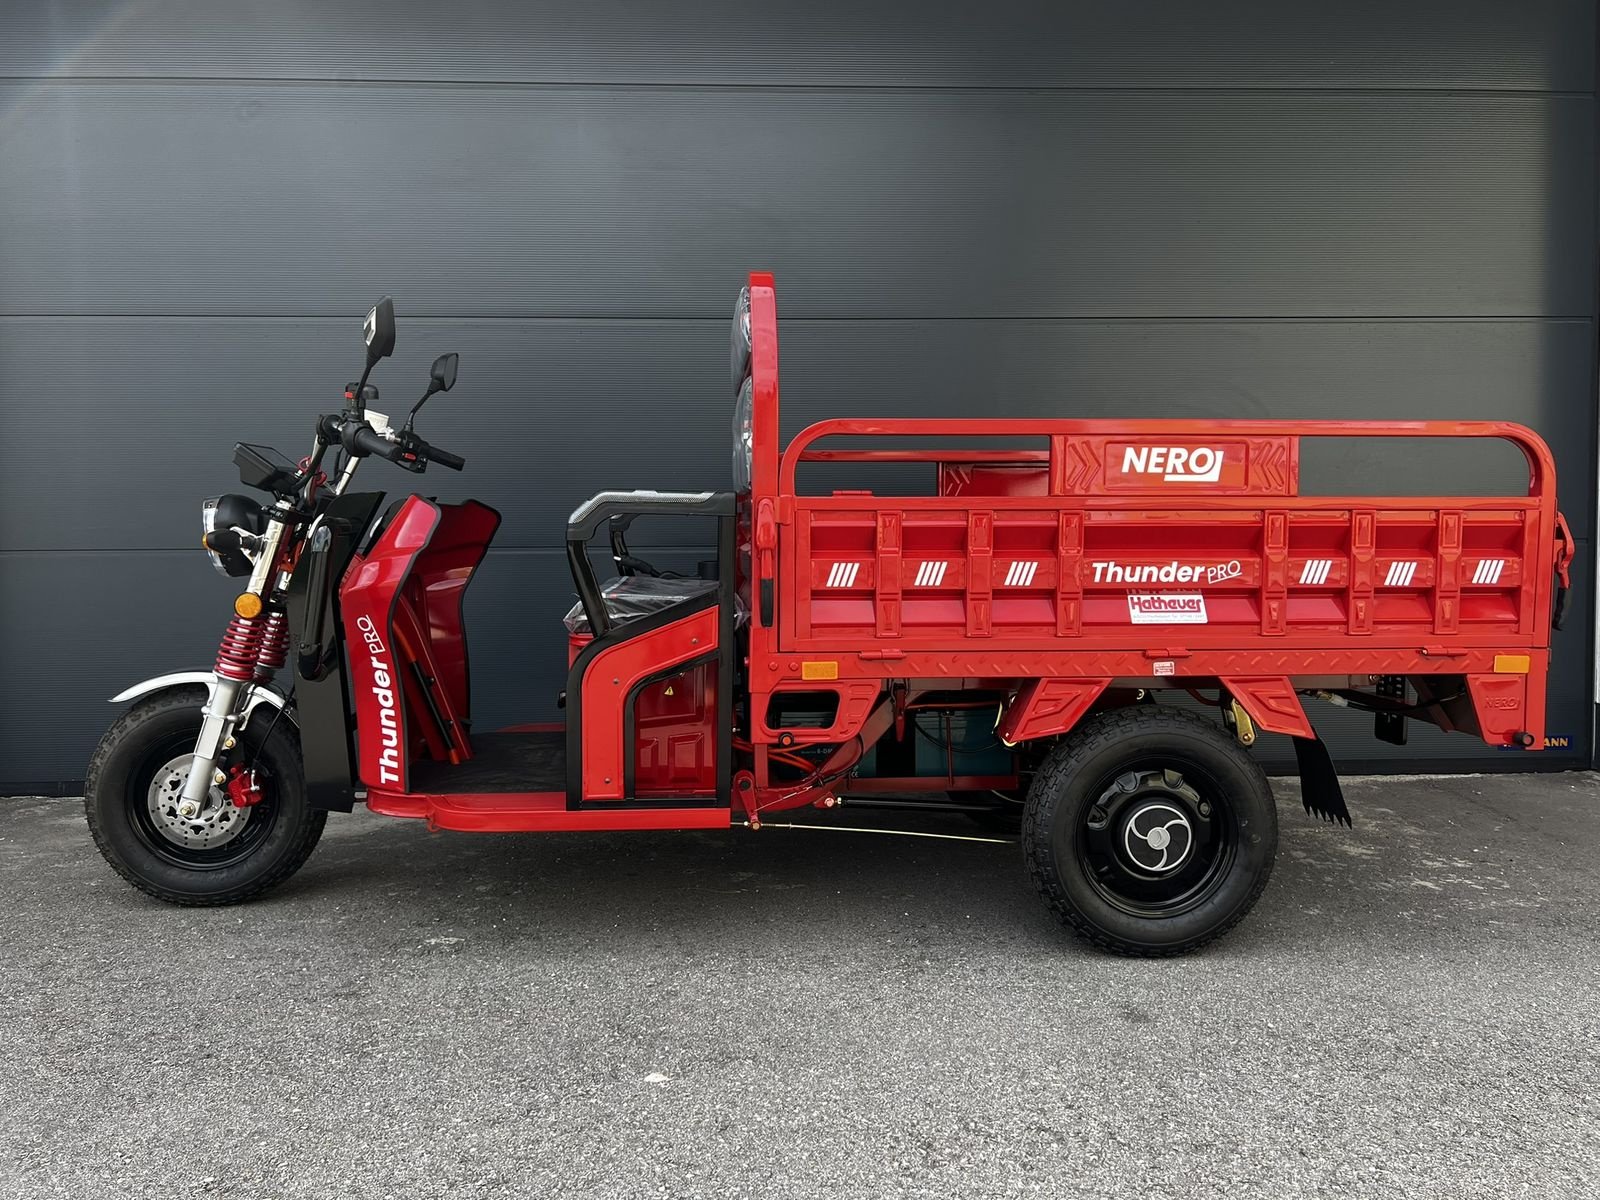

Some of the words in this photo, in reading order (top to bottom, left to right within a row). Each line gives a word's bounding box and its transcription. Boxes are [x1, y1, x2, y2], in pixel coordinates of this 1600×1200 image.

[1121, 447, 1216, 475] NERO
[1092, 561, 1206, 583] Thunder
[1207, 560, 1242, 584] PRO
[357, 614, 386, 653] PRO
[1484, 697, 1518, 709] NERO
[371, 656, 399, 784] Thunder
